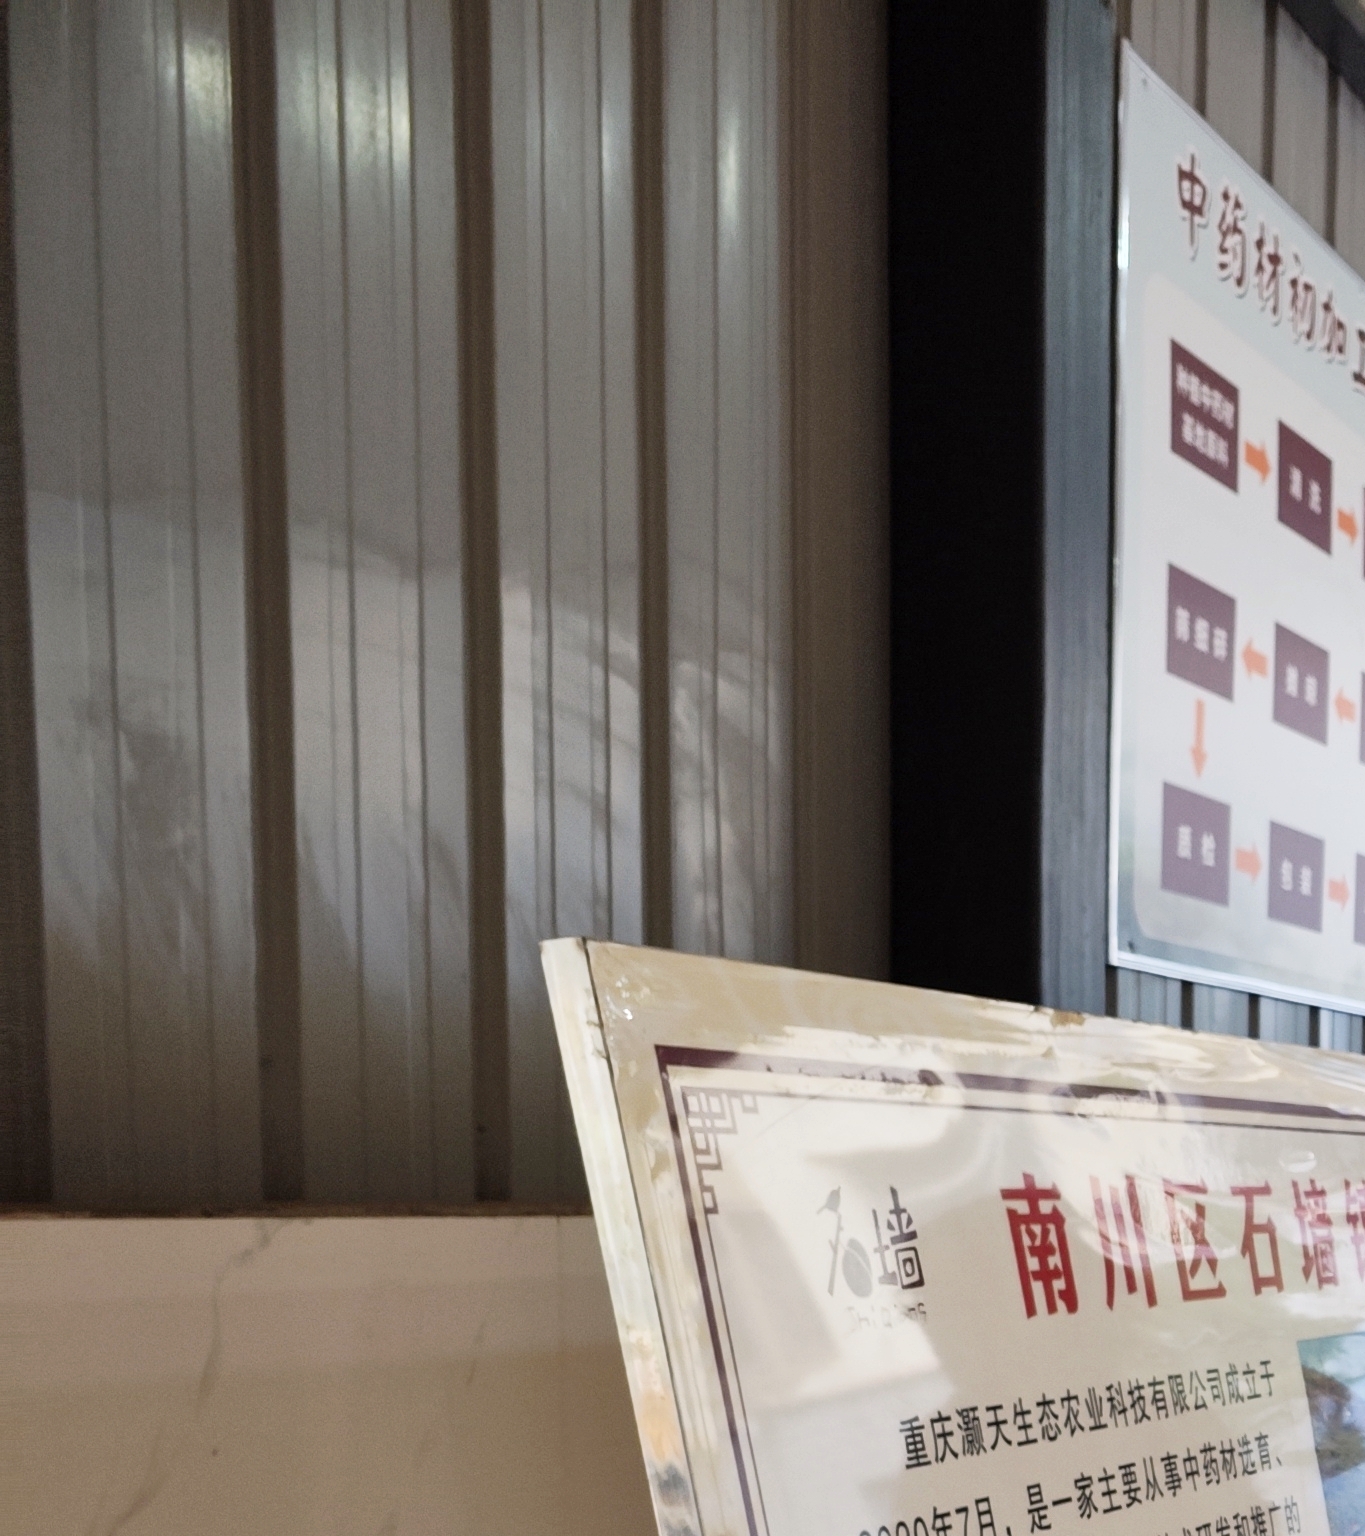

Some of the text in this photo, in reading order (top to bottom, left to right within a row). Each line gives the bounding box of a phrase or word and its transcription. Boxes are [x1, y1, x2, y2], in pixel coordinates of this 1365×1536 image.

[897, 1357, 1278, 1470] 重庆灏天生态农业科技有限公司成立于
